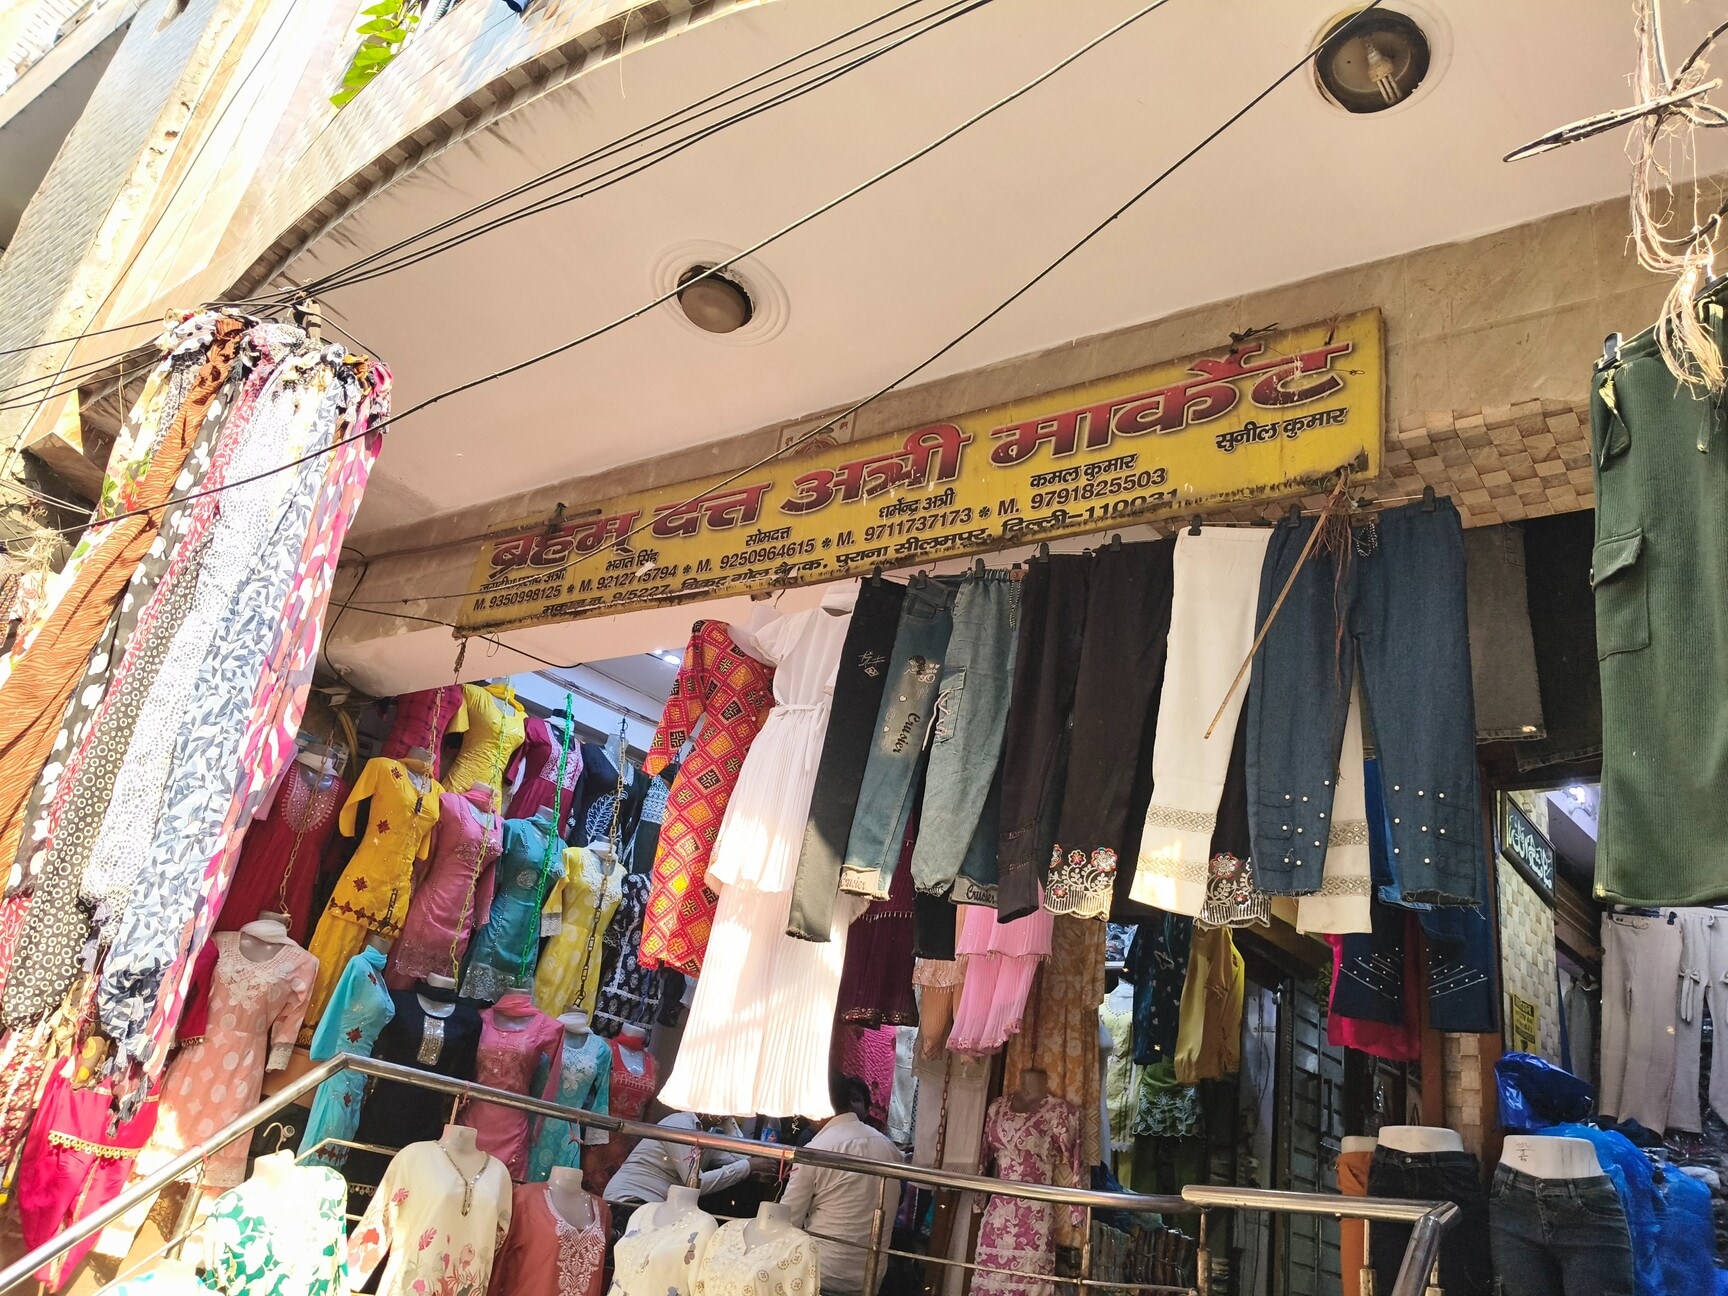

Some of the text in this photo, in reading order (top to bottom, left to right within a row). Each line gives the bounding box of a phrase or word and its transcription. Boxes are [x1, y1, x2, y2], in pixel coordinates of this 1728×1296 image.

[651, 481, 772, 537] दत्त
[779, 424, 973, 515] अत्री
[989, 341, 1352, 466] मार्केट
[1216, 408, 1348, 453] सुनील कुमार
[1030, 454, 1137, 488] कमल कुमार
[922, 487, 955, 511] अत्री
[473, 598, 486, 611] M.
[489, 585, 562, 608] 9350998125
[578, 579, 593, 593] M.
[696, 559, 713, 574] M.
[720, 538, 816, 569] 9250964615
[836, 530, 855, 547] M.
[864, 507, 973, 541] 9711737173
[997, 498, 1020, 516] M.
[1030, 468, 1167, 510] 9791825503
[745, 526, 792, 547] सोमदत्त
[605, 556, 635, 571] भगत
[836, 545, 891, 568] पुराना
